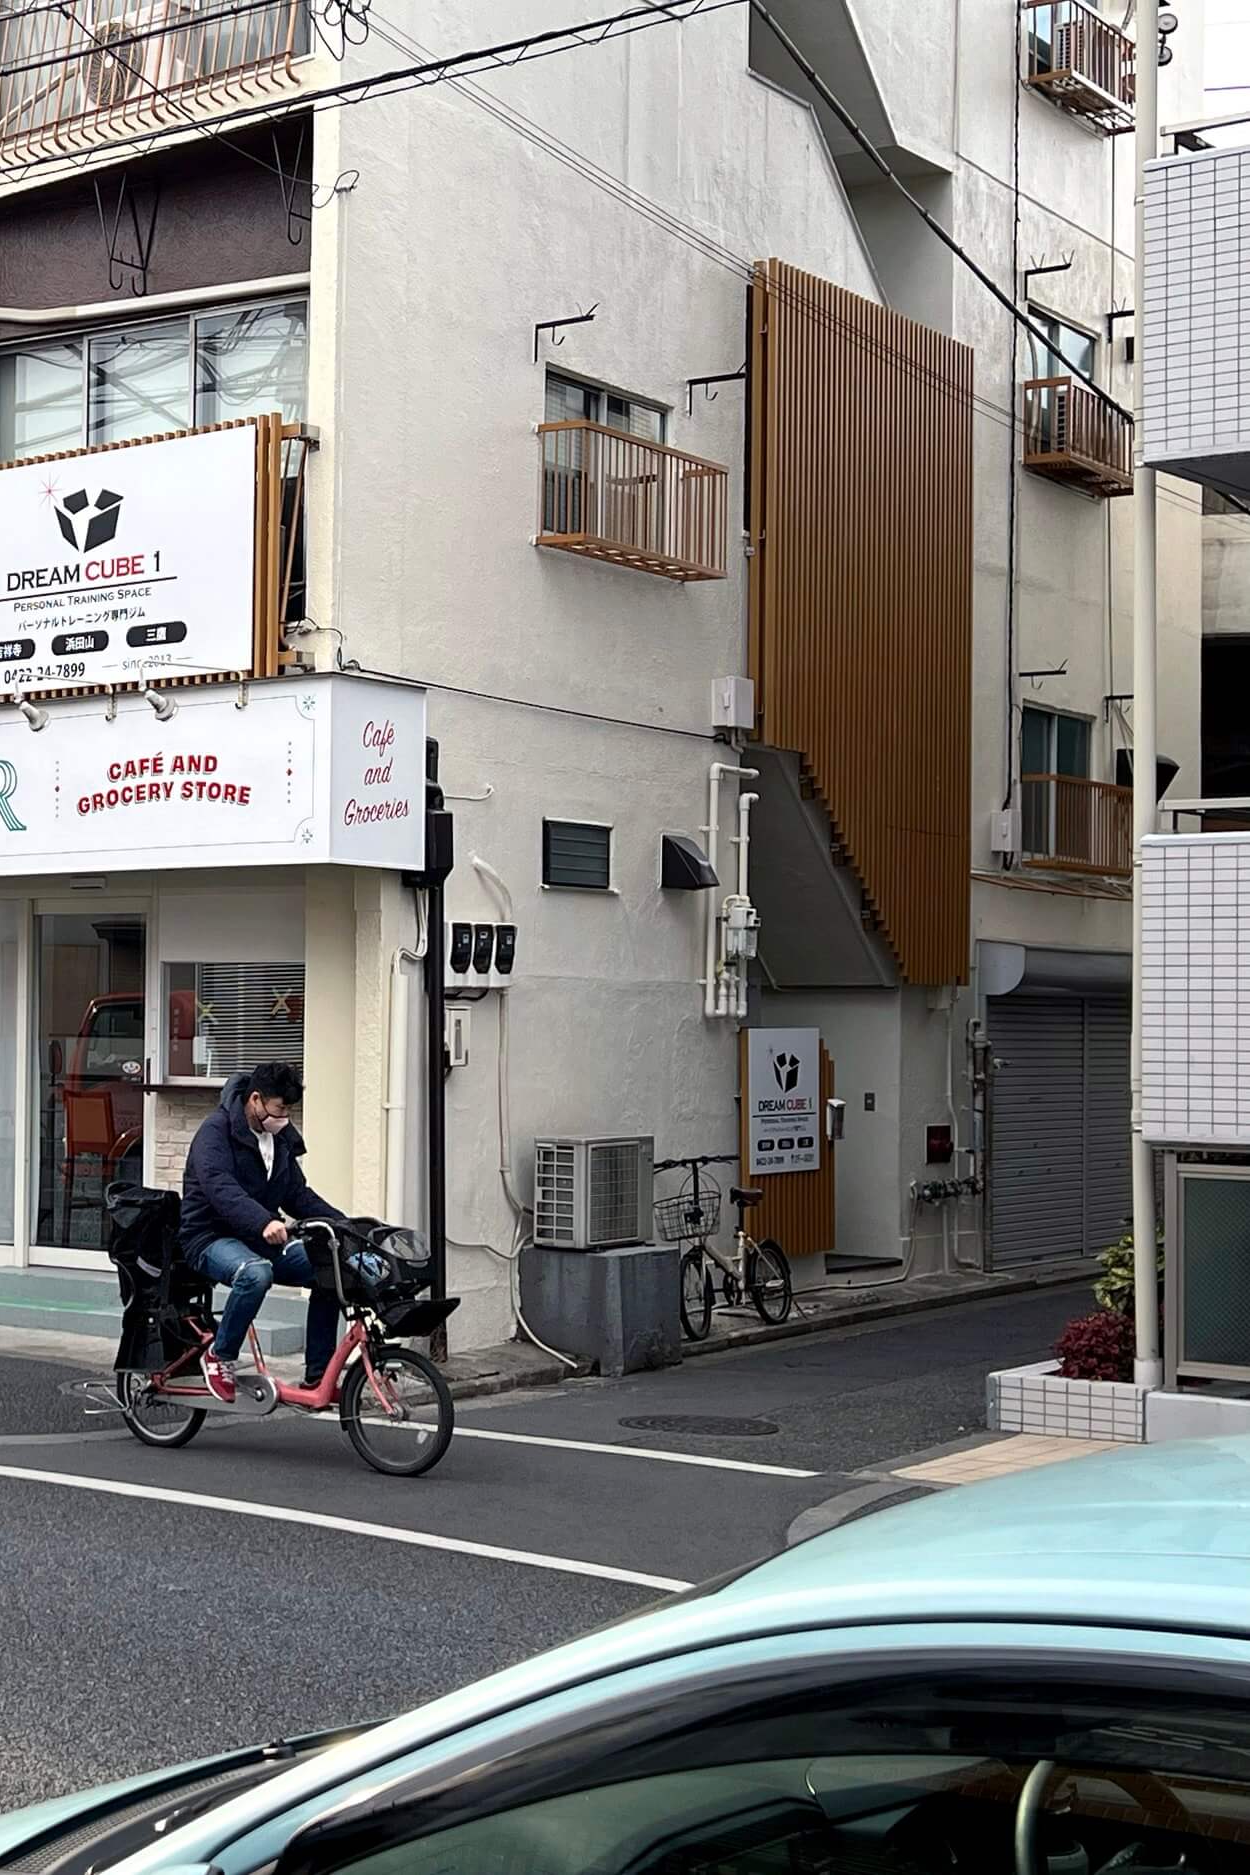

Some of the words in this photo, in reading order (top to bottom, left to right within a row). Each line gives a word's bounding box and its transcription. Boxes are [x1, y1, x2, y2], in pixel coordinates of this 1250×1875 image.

[6, 563, 81, 592] DREAM
[84, 555, 145, 581] CUBE
[153, 550, 161, 572] 1
[18, 606, 146, 632] パーソナルトレーニング専門ジム
[65, 635, 95, 651] 浜田山
[362, 719, 395, 757] Café
[107, 751, 164, 782] CAFÉ
[170, 755, 218, 775] AND
[364, 757, 393, 786] and
[77, 781, 174, 816] GROCERY
[181, 781, 252, 806] STORE
[344, 797, 410, 826] Groceries
